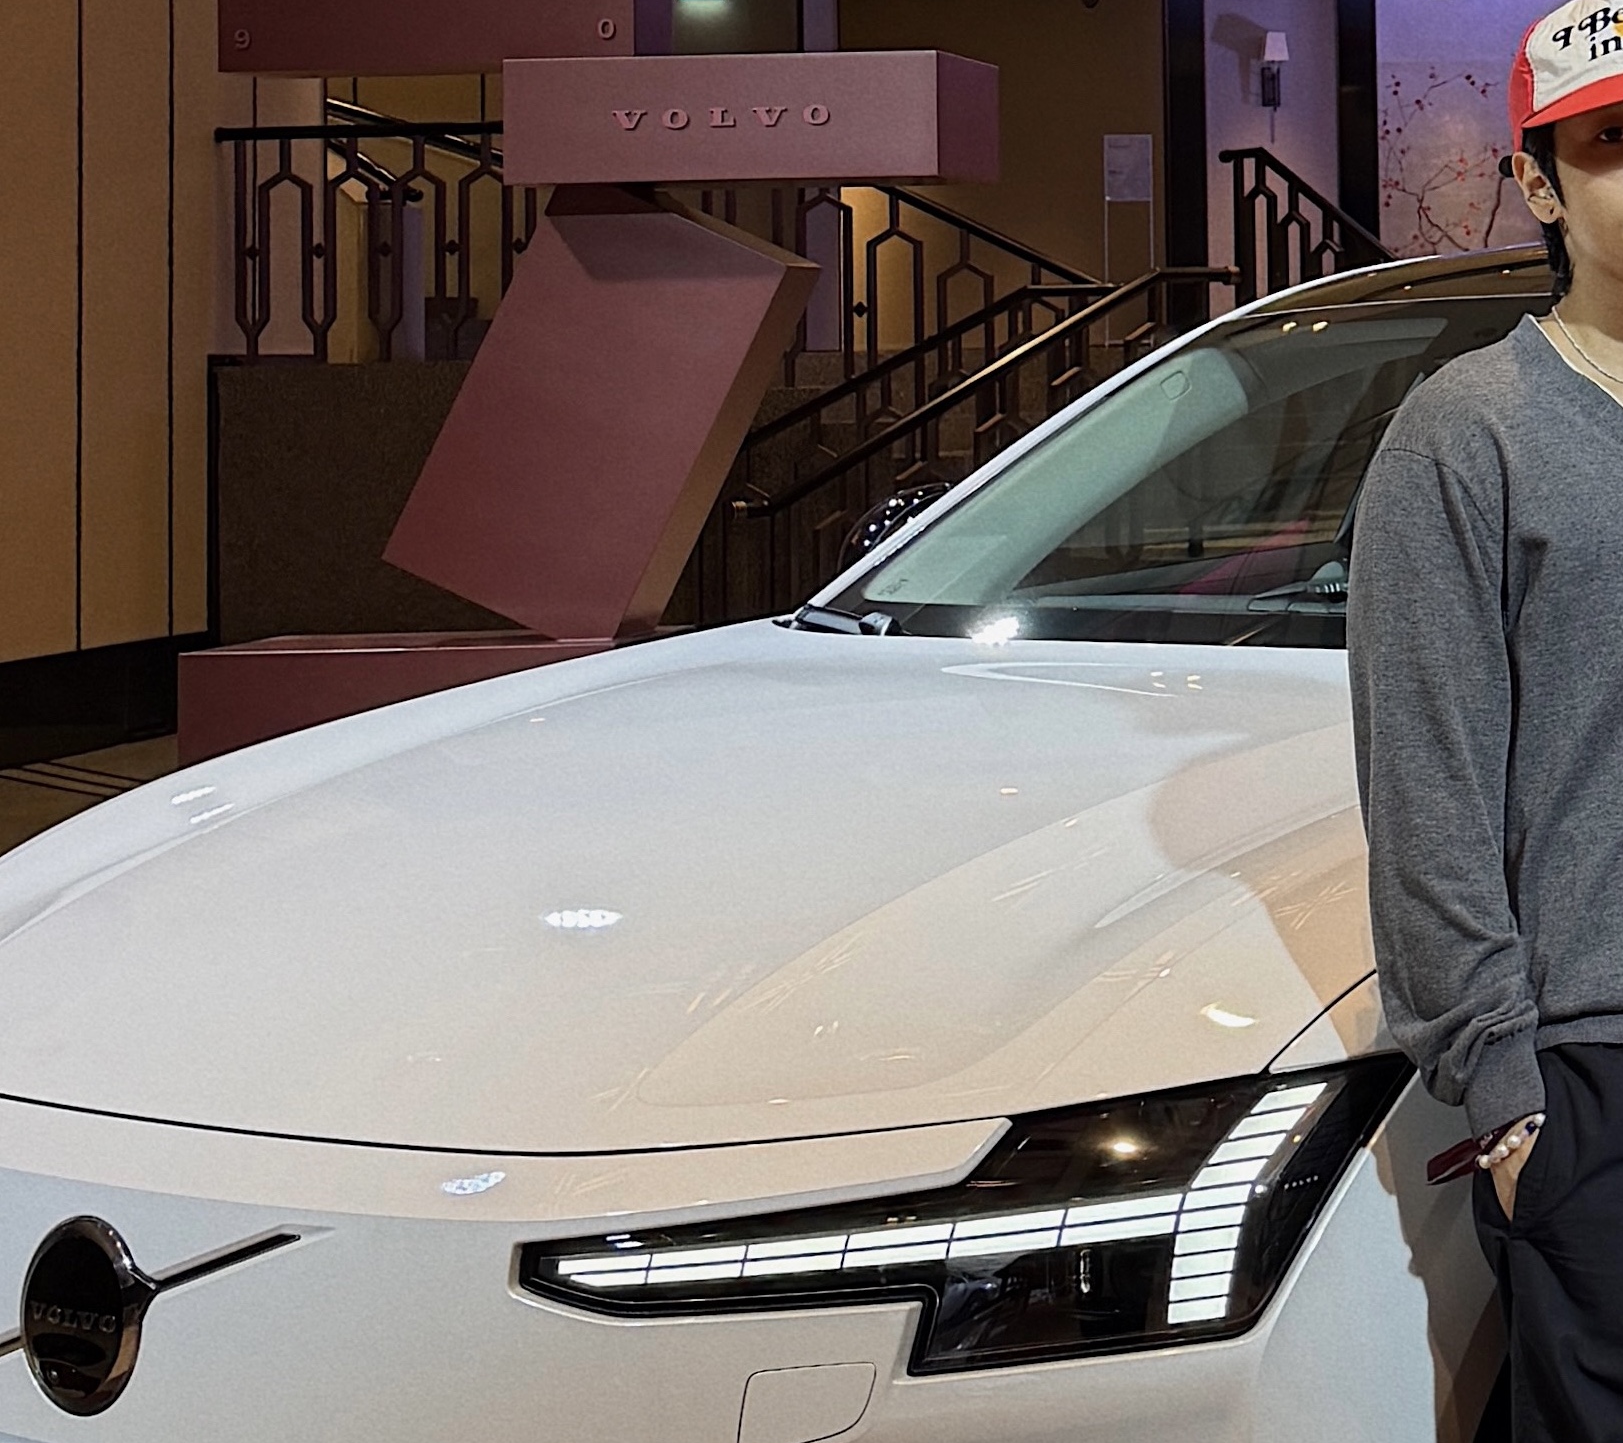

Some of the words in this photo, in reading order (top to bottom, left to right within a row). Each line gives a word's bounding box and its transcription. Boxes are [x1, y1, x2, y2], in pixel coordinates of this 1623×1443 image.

[234, 29, 251, 50] 9
[1588, 36, 1622, 61] in
[611, 104, 831, 131] VOLVO
[30, 1300, 117, 1333] VOLVO
